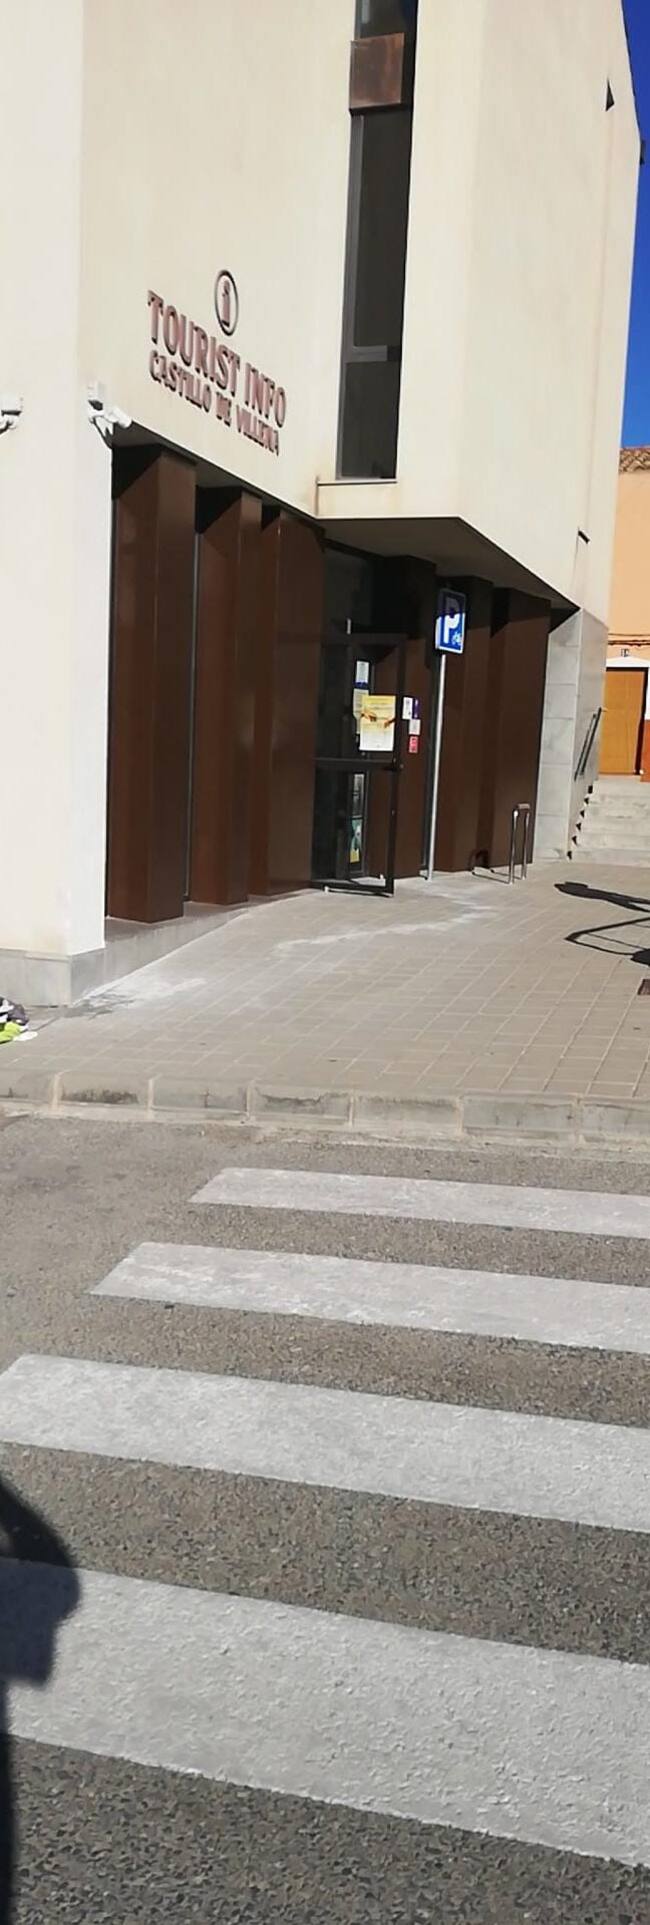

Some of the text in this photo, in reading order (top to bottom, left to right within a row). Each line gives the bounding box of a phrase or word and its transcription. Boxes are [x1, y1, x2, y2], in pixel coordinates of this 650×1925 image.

[148, 290, 286, 428] TOURIST INFO
[150, 350, 279, 456] CASTILLO DE VILLENA
[443, 597, 460, 644] P
